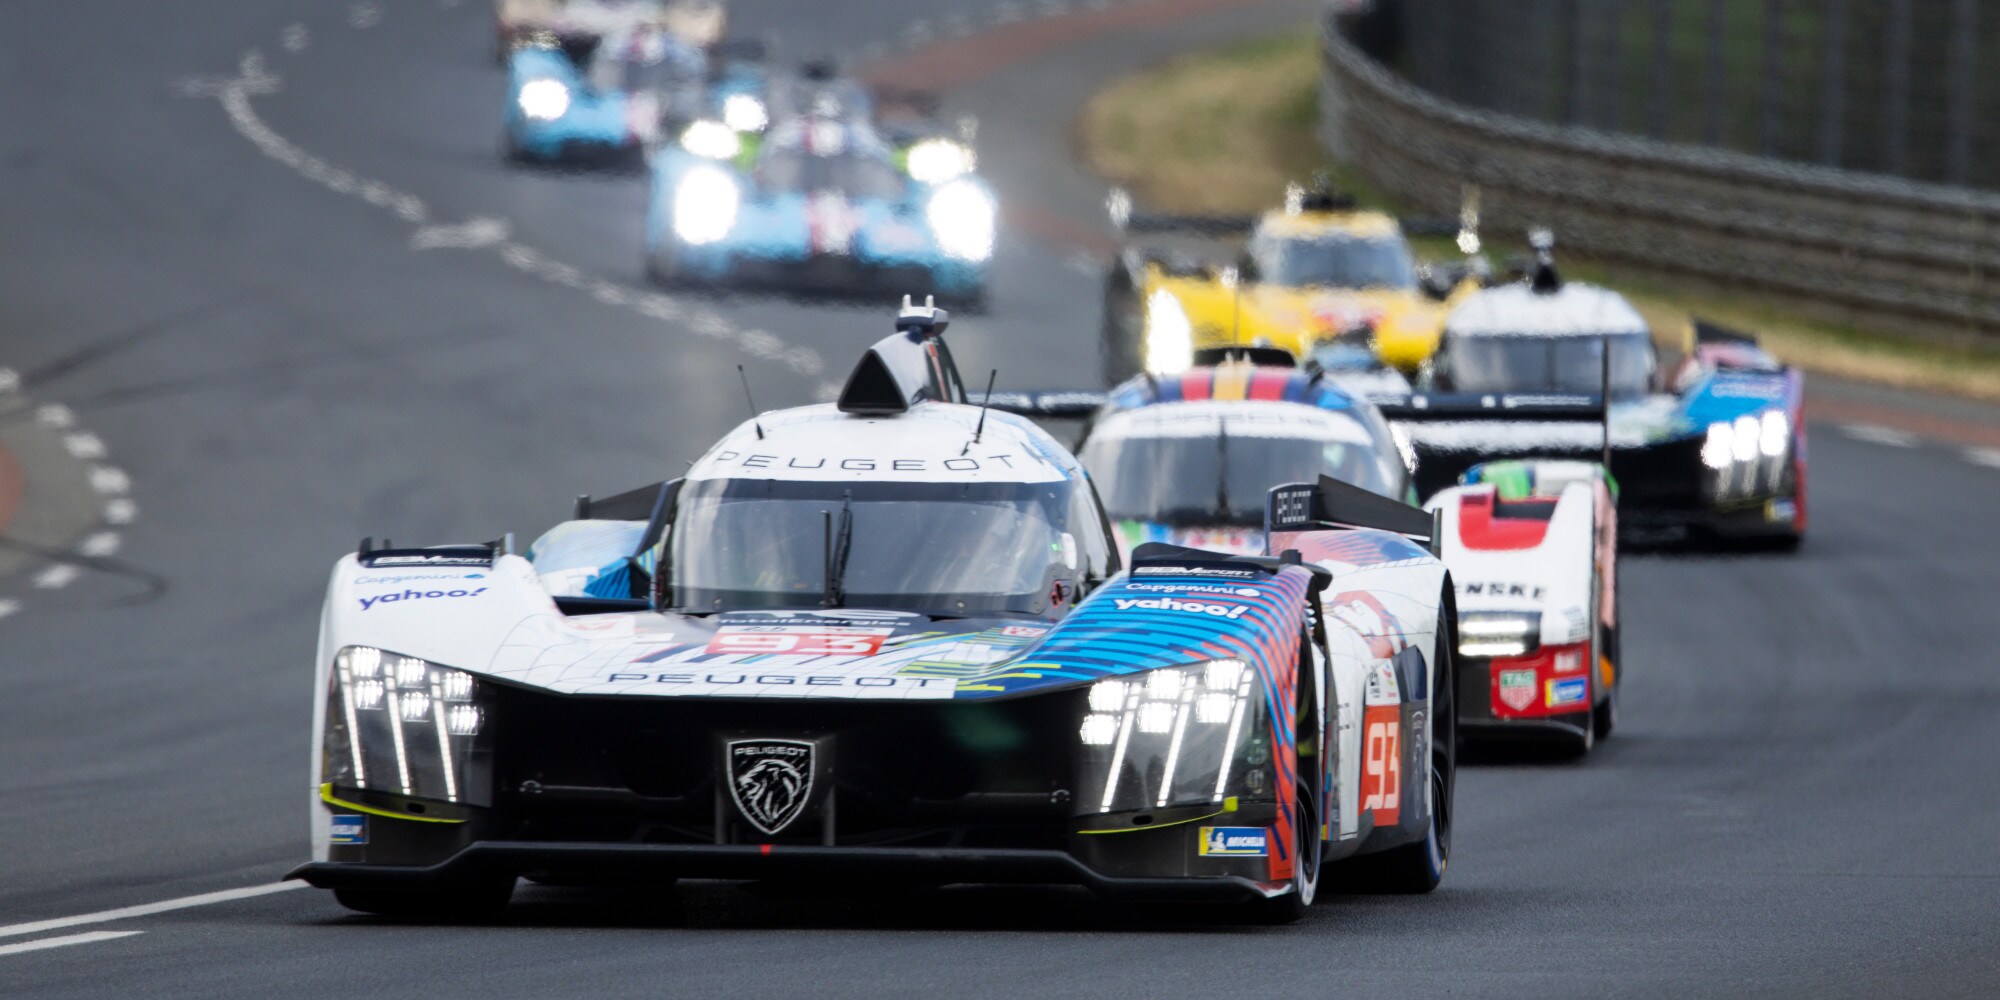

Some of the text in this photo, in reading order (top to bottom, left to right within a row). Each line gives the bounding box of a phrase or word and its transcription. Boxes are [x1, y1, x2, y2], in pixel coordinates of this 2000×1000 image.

[713, 451, 1013, 472] PEUGEOT
[1126, 583, 1235, 593] Capgemini
[359, 587, 489, 611] yahoo!
[1115, 598, 1249, 619] yahoo!
[713, 634, 874, 654] 93
[609, 673, 944, 688] PEUGEOT
[734, 746, 808, 757] PEUGEOT
[1364, 722, 1399, 810] 93
